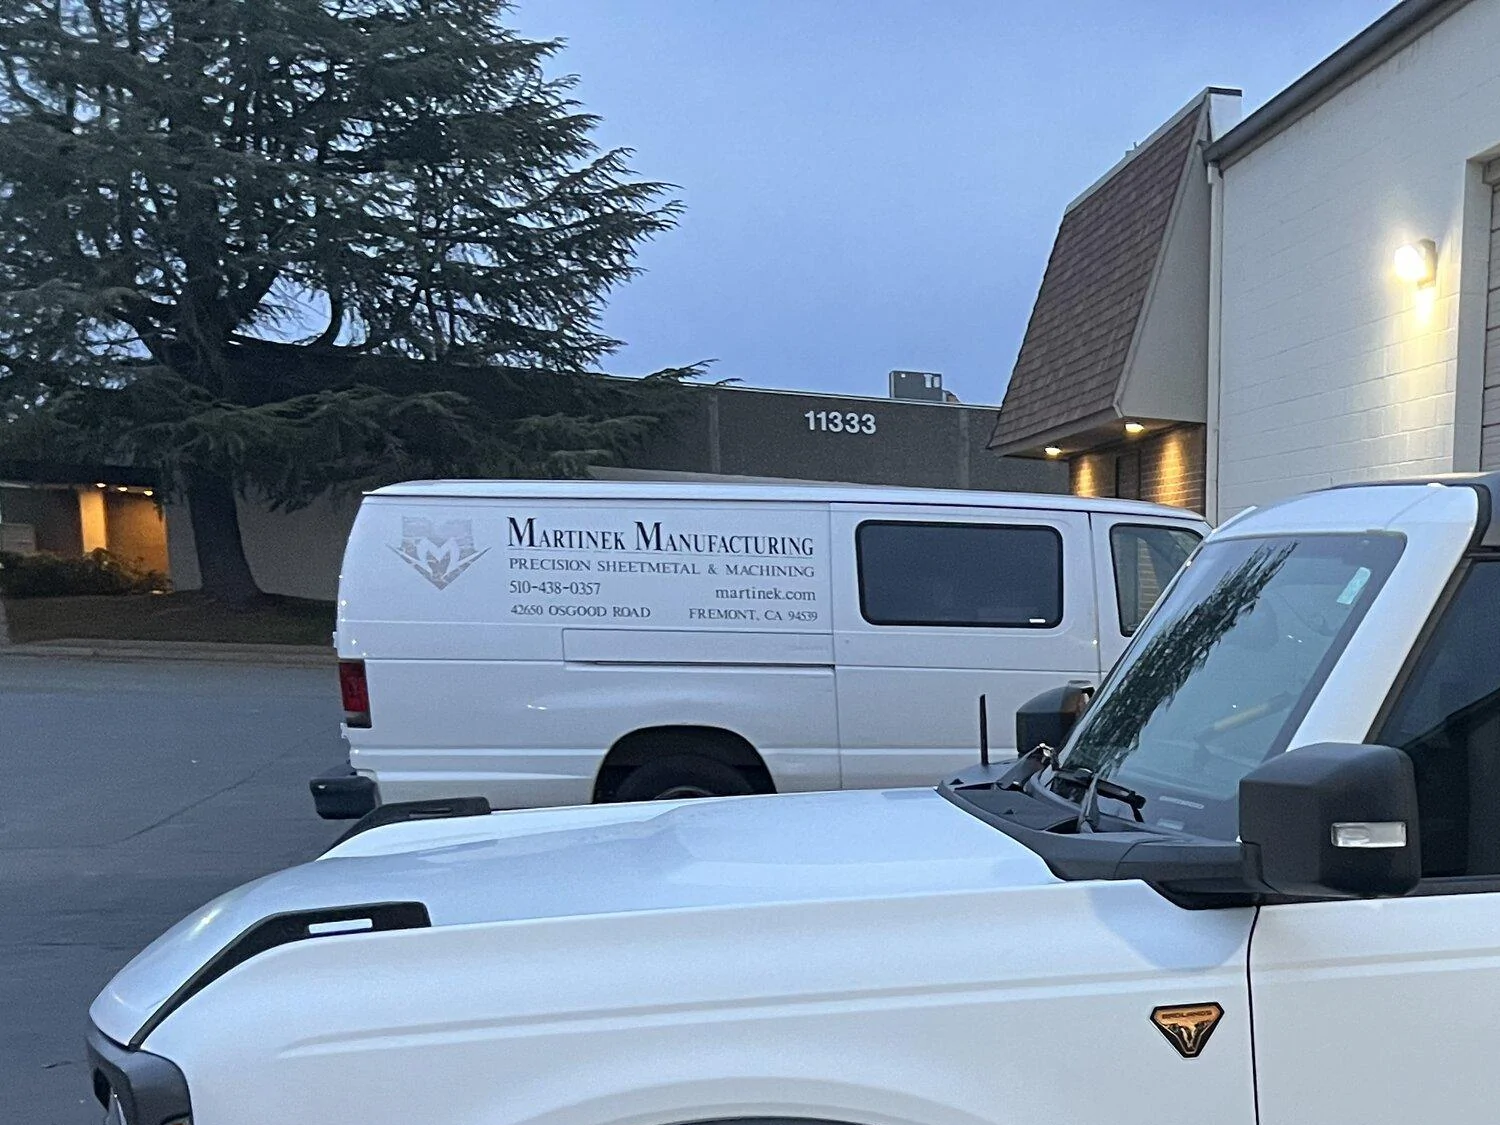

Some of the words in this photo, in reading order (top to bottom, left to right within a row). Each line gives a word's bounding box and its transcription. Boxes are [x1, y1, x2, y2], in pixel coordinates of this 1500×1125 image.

[804, 410, 877, 435] 11333
[507, 516, 626, 550] MARTINEK
[633, 521, 814, 556] MANUFACTURING
[509, 557, 591, 573] PRECISION
[597, 560, 701, 575] SHEETMETAL
[707, 563, 718, 575] &
[725, 563, 815, 578] MACHINING
[509, 579, 601, 596] 510-438-0357
[715, 586, 817, 601] martinek.com
[510, 604, 544, 616] 42650
[548, 604, 607, 618] OSGOOD
[612, 606, 651, 618] ROAD
[764, 609, 783, 621] CA
[787, 610, 819, 622] 94539
